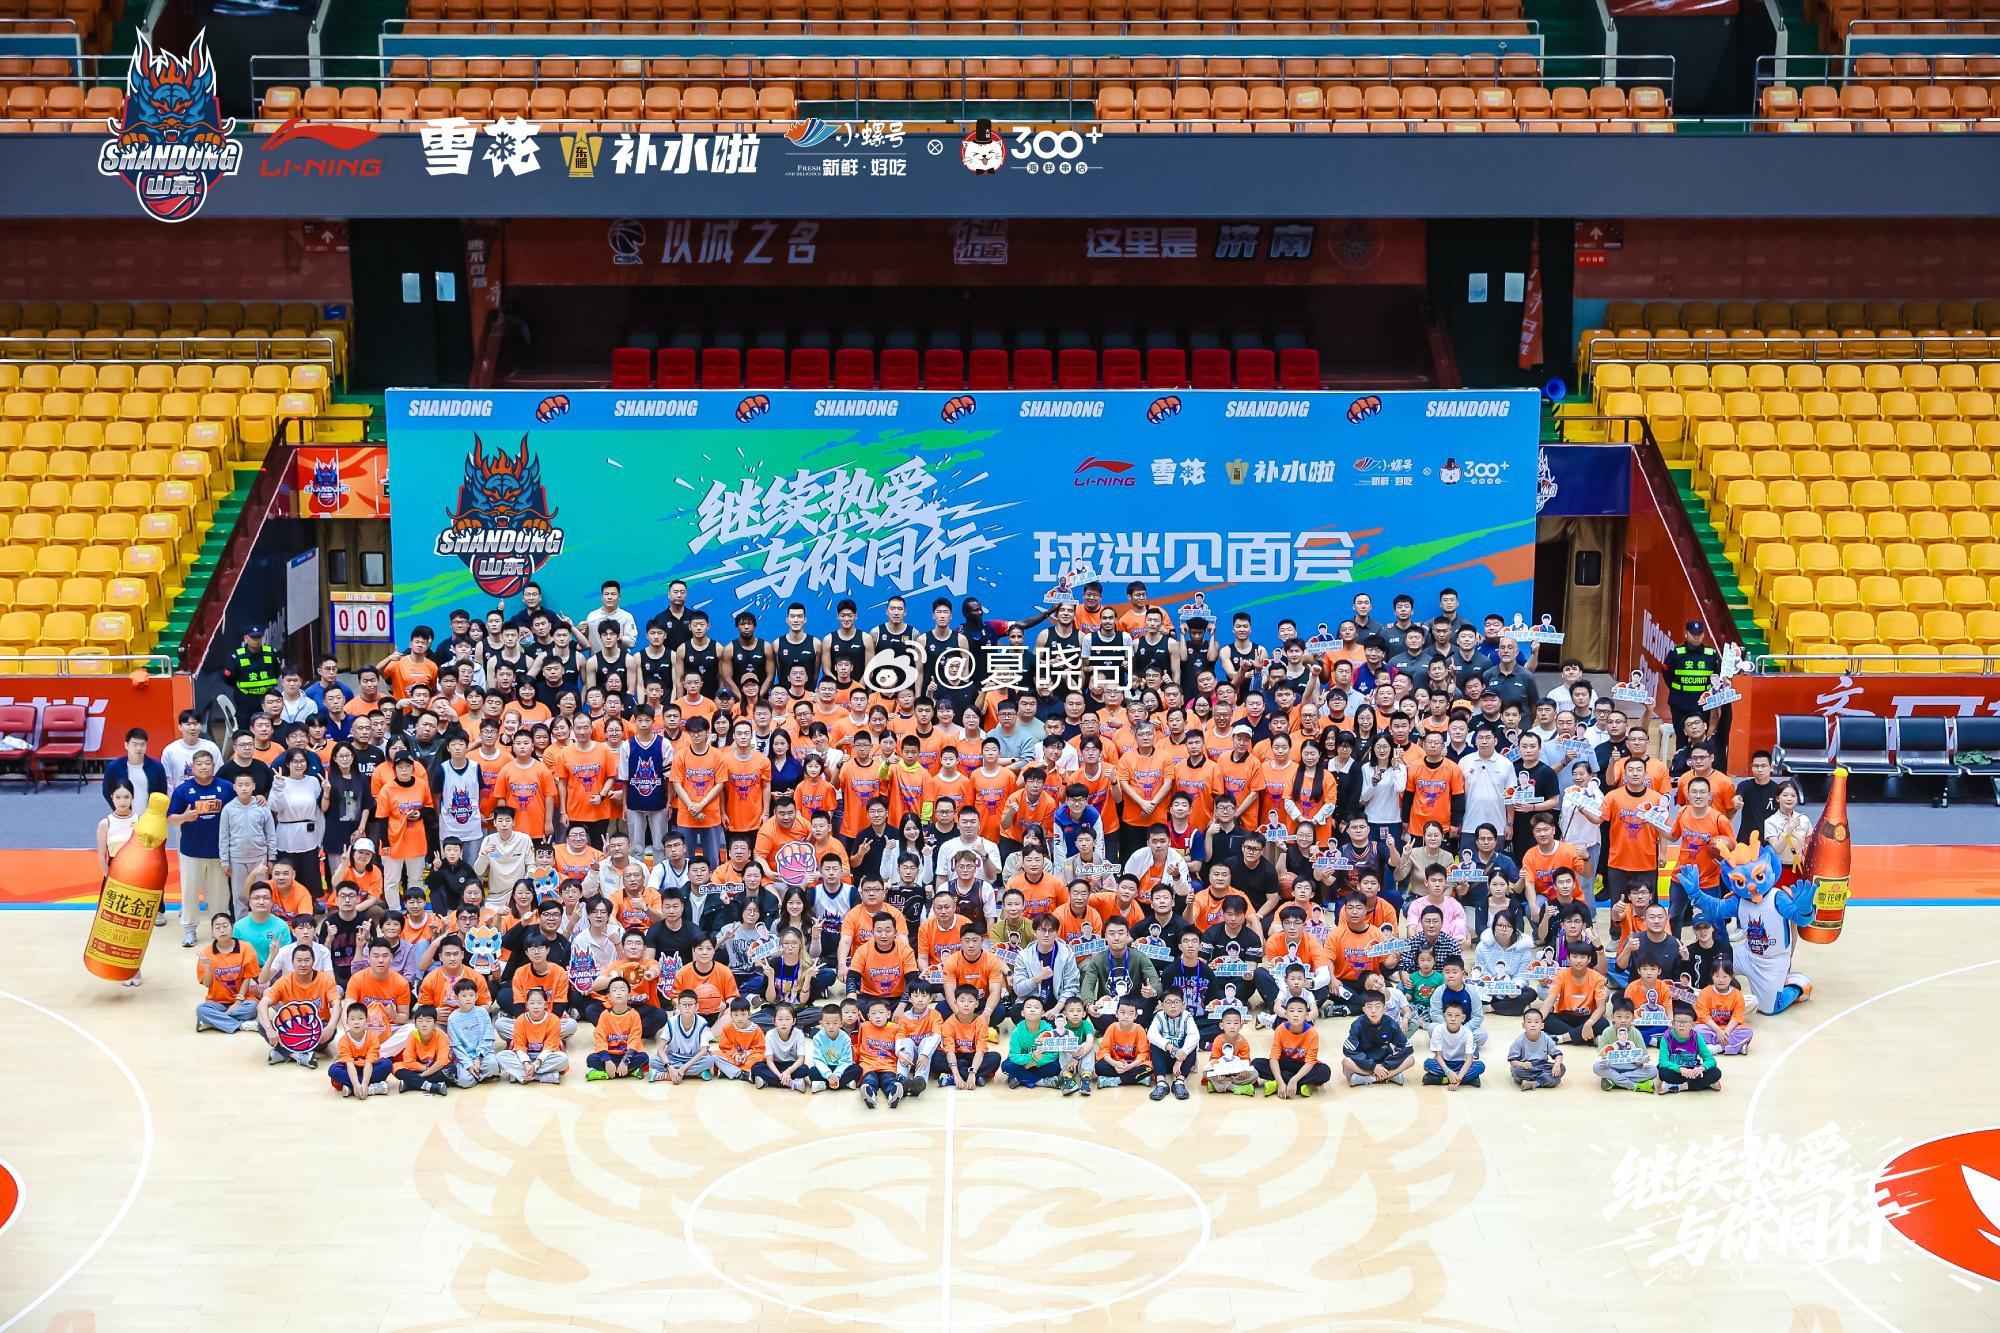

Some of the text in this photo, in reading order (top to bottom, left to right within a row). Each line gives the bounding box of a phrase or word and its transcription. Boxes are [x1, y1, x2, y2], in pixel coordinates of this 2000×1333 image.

[662, 219, 820, 265] 以城之名
[1087, 228, 1197, 259] 这里是
[408, 400, 493, 417] SHANDONG
[614, 400, 698, 417] SHANDONG
[814, 400, 899, 417] SHANDONG
[1020, 400, 1104, 418] SHANDONG
[1225, 400, 1311, 418] SHANDONG
[1425, 400, 1511, 417] SHANDONG
[1151, 457, 1207, 486] 雪花
[1254, 460, 1336, 483] 补水啦
[1074, 477, 1136, 486] LI-NING
[688, 455, 938, 555] 继续热爱
[439, 529, 562, 554] SHANDONG
[735, 522, 985, 599] 与你同行
[1033, 531, 1355, 583] 球迷见面会
[478, 557, 526, 576] 山东
[1684, 661, 1706, 669] 安保
[248, 671, 268, 681] 安保
